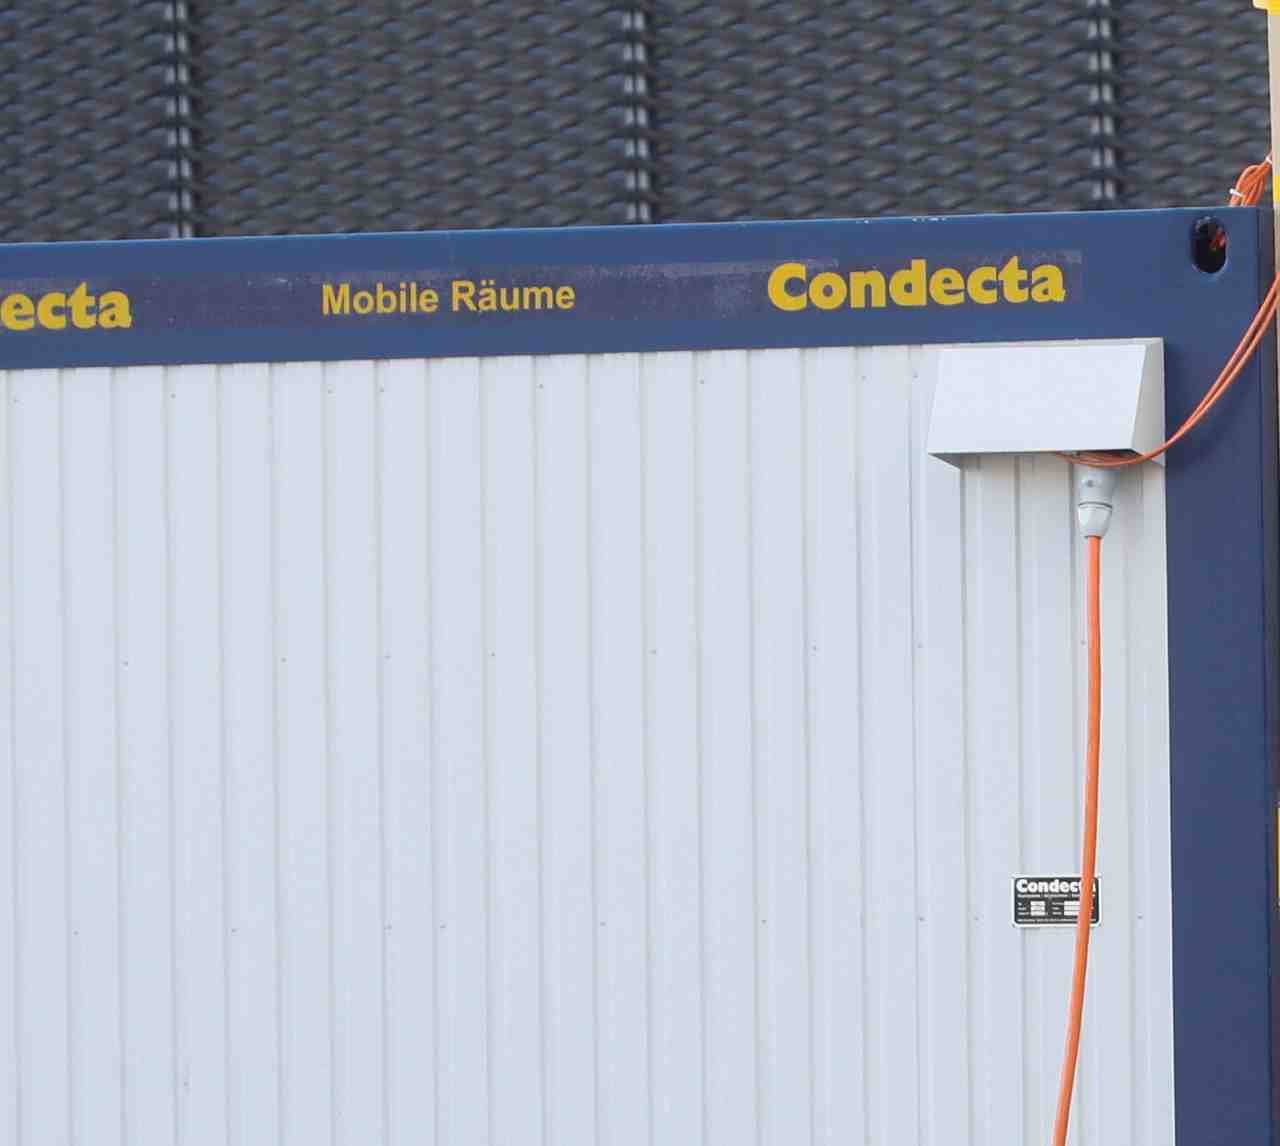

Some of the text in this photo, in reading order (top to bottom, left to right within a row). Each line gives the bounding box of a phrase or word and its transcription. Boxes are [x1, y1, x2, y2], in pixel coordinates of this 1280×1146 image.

[321, 278, 575, 316] Mobile Räume
[767, 255, 1066, 312] Condecta
[1016, 878, 1096, 893] Condec
